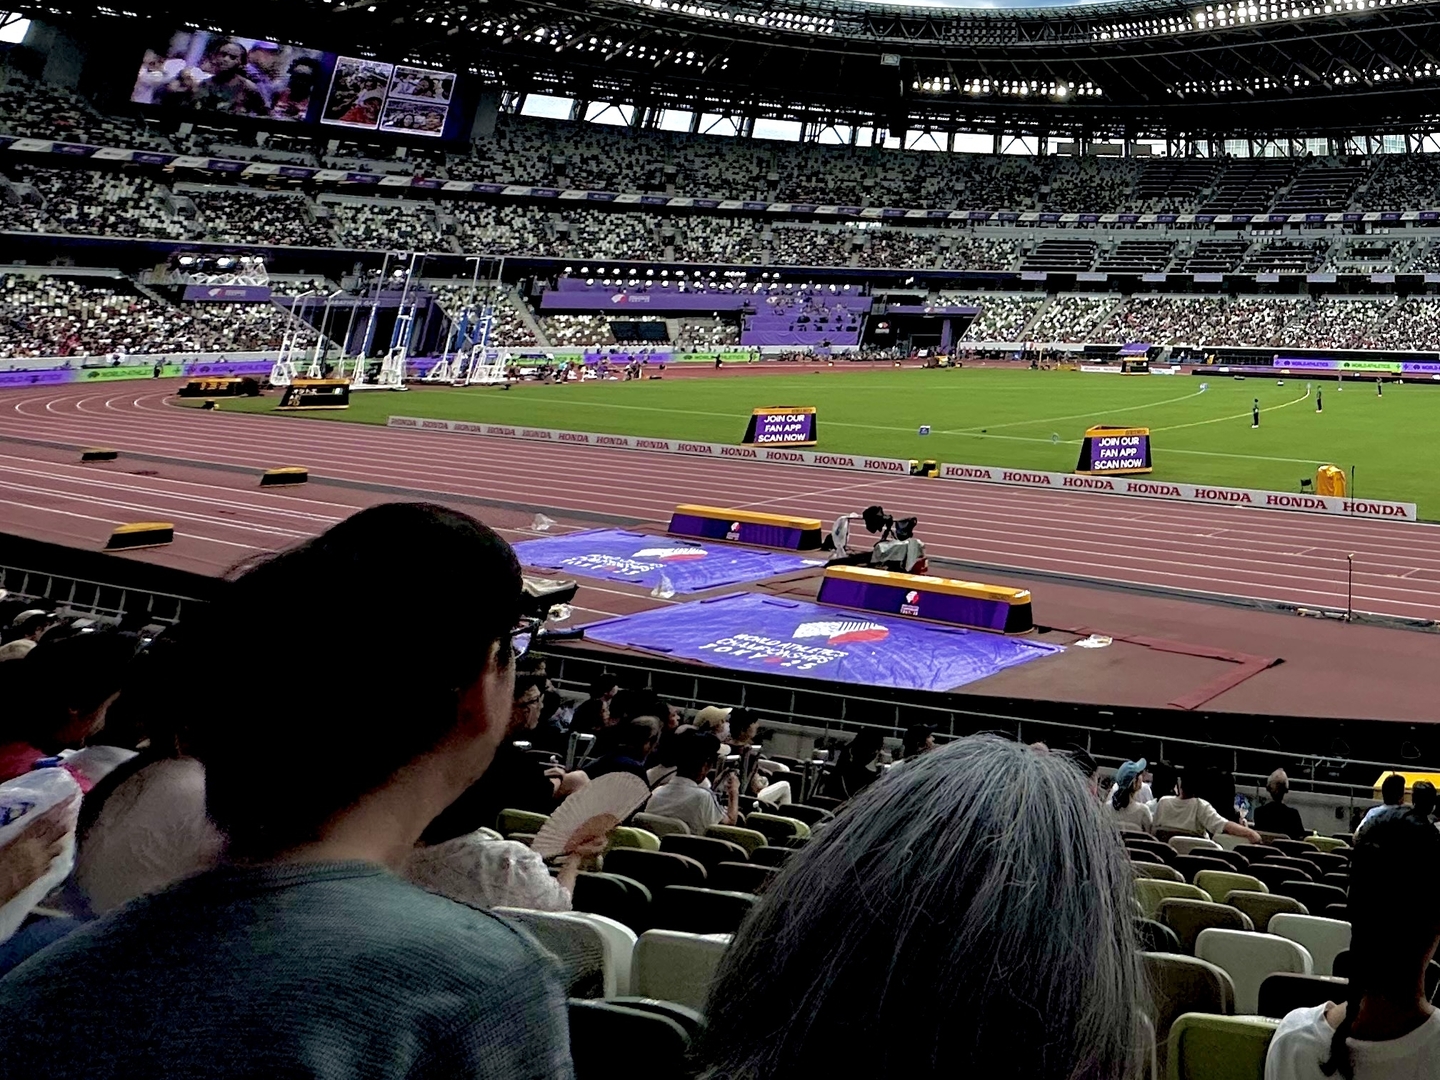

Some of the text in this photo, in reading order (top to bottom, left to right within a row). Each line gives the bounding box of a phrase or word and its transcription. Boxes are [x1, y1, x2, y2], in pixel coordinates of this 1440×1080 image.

[786, 414, 805, 422] OUR
[765, 424, 802, 432] FAN APP
[758, 434, 782, 442] SCAN
[1099, 437, 1139, 446] JOIN OUR
[558, 432, 589, 443] HONDA
[596, 436, 628, 446] HONDA
[636, 439, 670, 450] HONDA
[678, 442, 712, 454] HONDA
[720, 446, 757, 458] HONDA
[766, 451, 804, 462] HONDA
[814, 455, 854, 467] HONDA
[864, 460, 904, 472] HONDA
[1100, 448, 1137, 458] FAN APP
[1094, 459, 1142, 469] SCAN NOW
[946, 466, 1407, 517] HONDA HONDA HONDA HONDA HONDA HONDA HONDA
